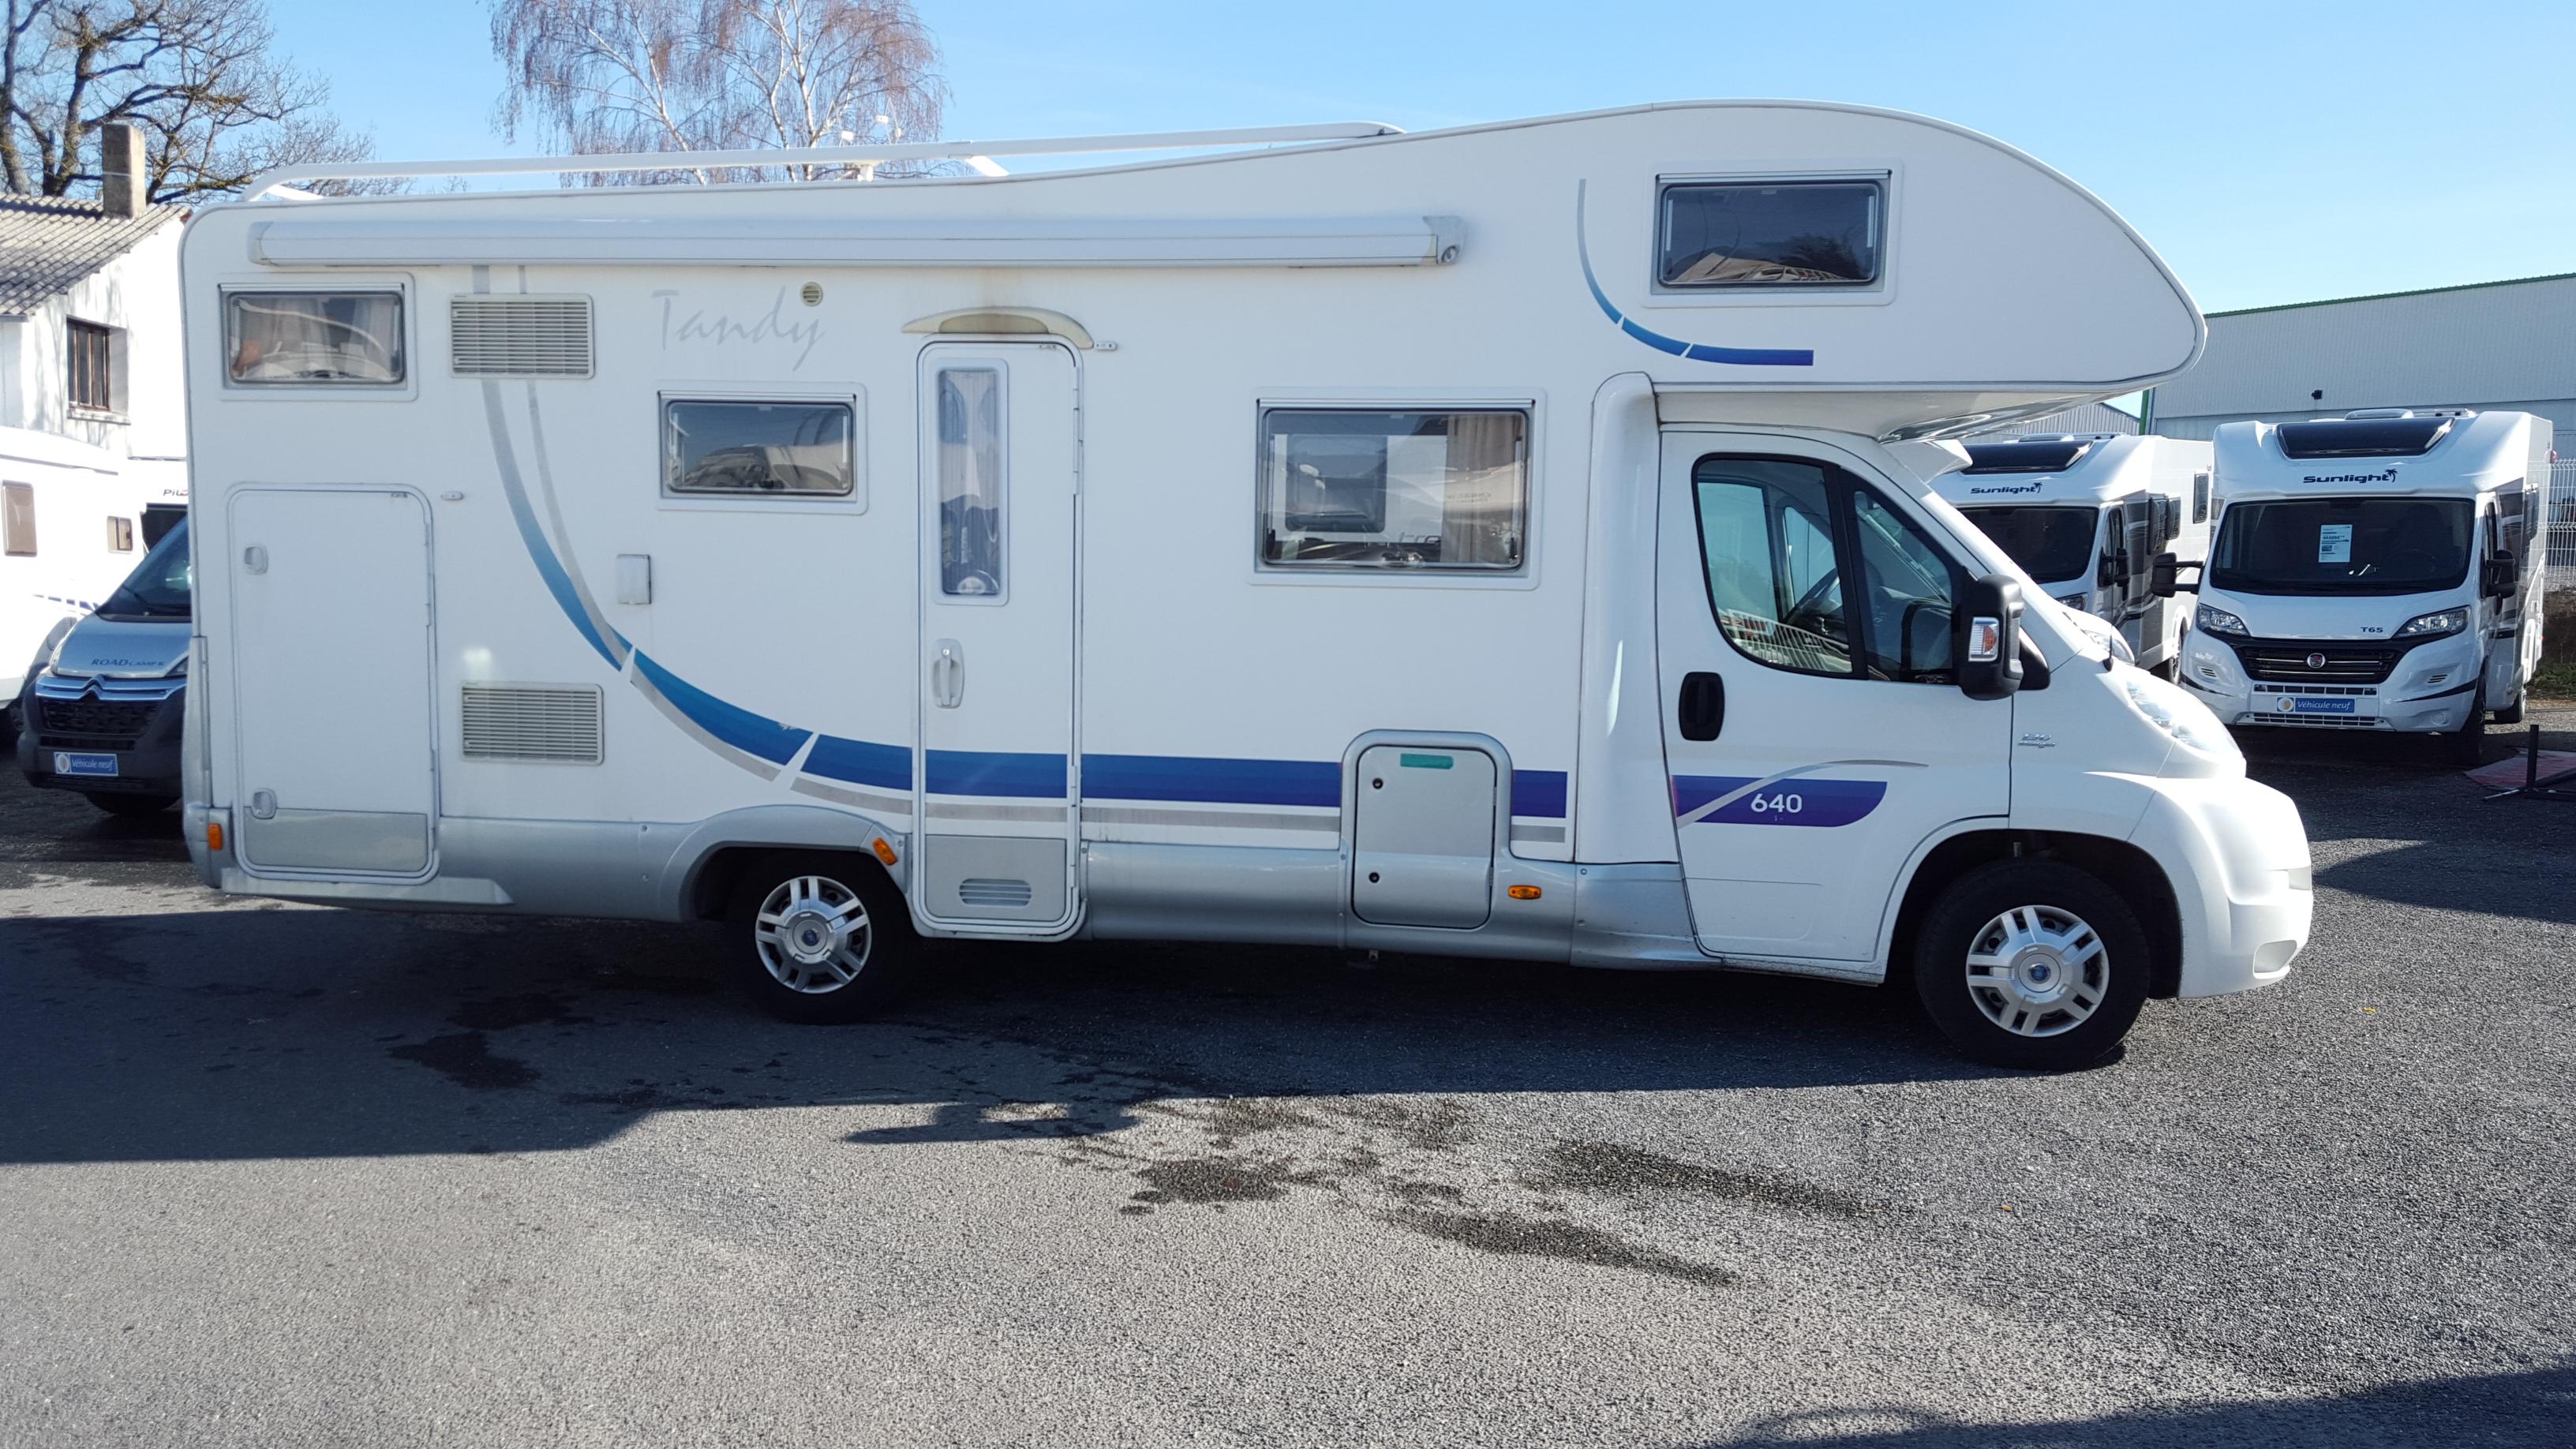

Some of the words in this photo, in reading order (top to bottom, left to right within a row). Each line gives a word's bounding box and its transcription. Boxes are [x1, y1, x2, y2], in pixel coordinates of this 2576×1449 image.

[651, 284, 826, 372] Tandy
[2302, 474, 2390, 484] Sunlight
[2297, 699, 2331, 709] Véhicule
[2331, 701, 2352, 711] neuf
[1750, 793, 1803, 814] 640
